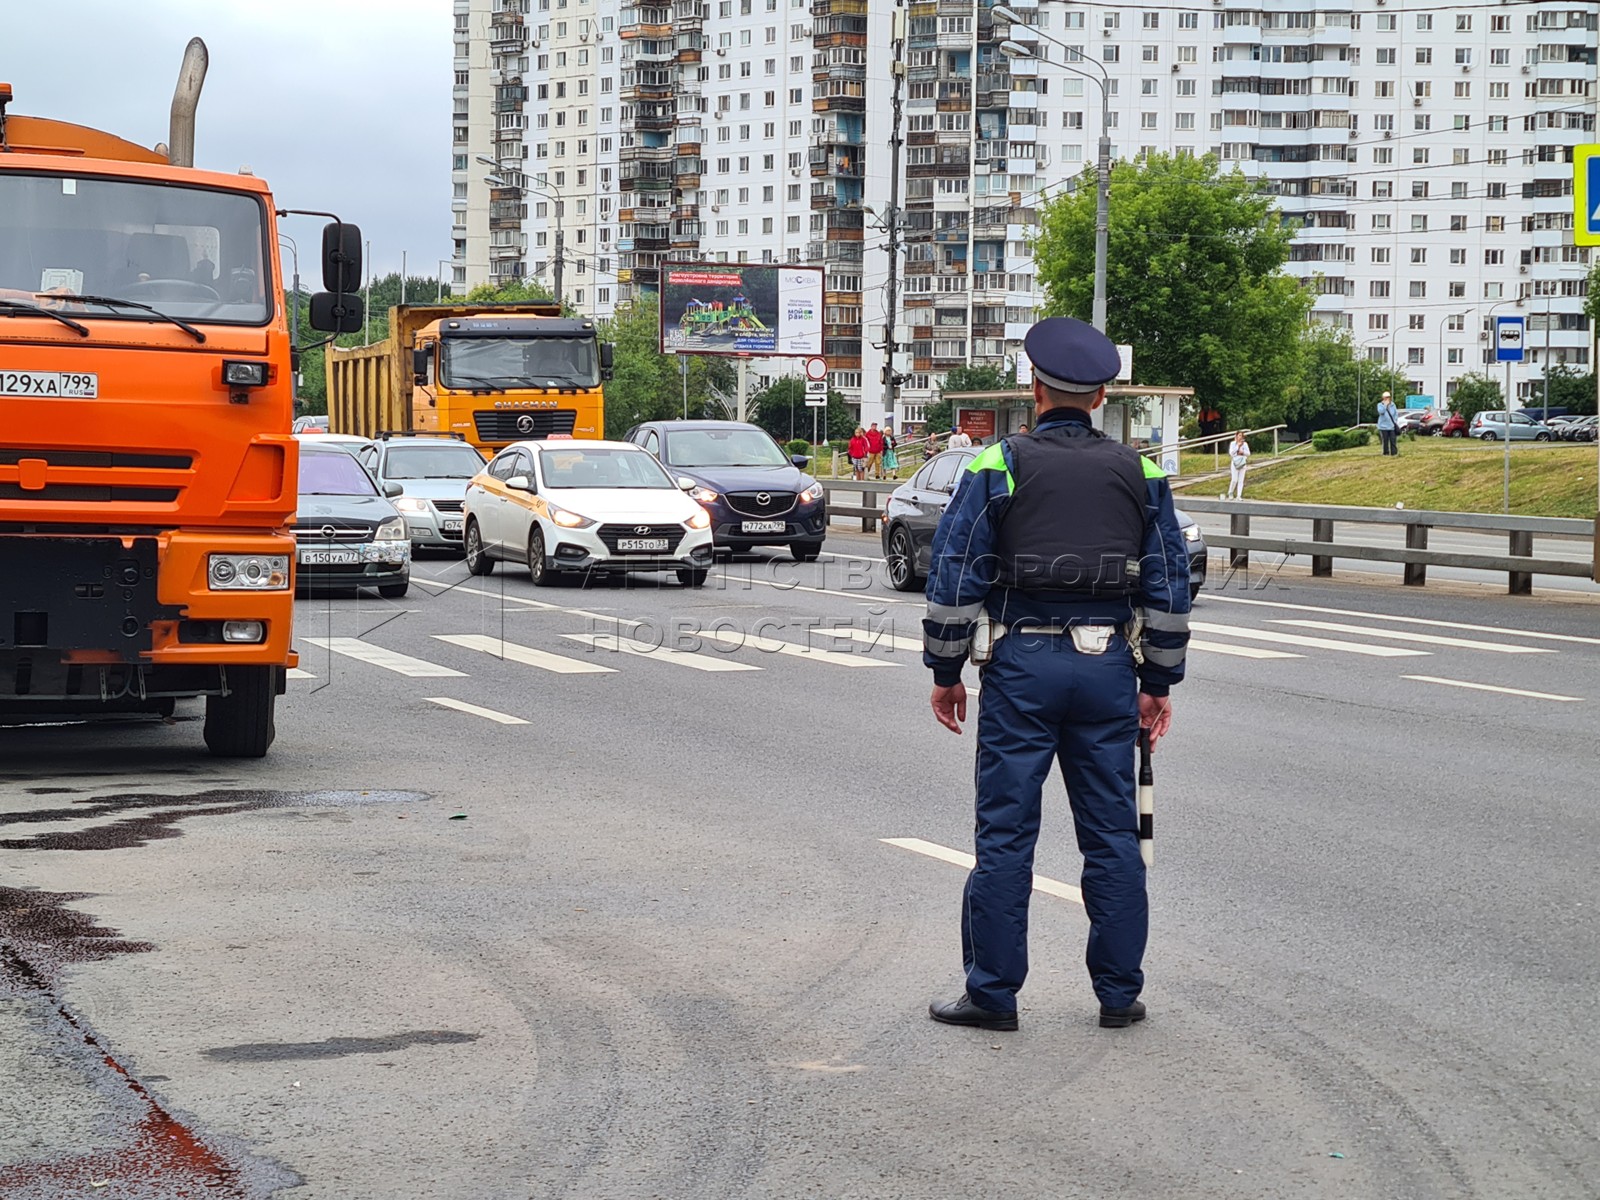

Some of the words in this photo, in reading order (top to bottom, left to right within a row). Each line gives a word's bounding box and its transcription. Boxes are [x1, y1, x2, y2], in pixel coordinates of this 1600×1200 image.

[785, 276, 816, 284] МОСКВА
[62, 374, 91, 390] 799
[494, 401, 558, 409] SHACMAN
[657, 539, 666, 547] 33
[345, 552, 356, 561] 77
